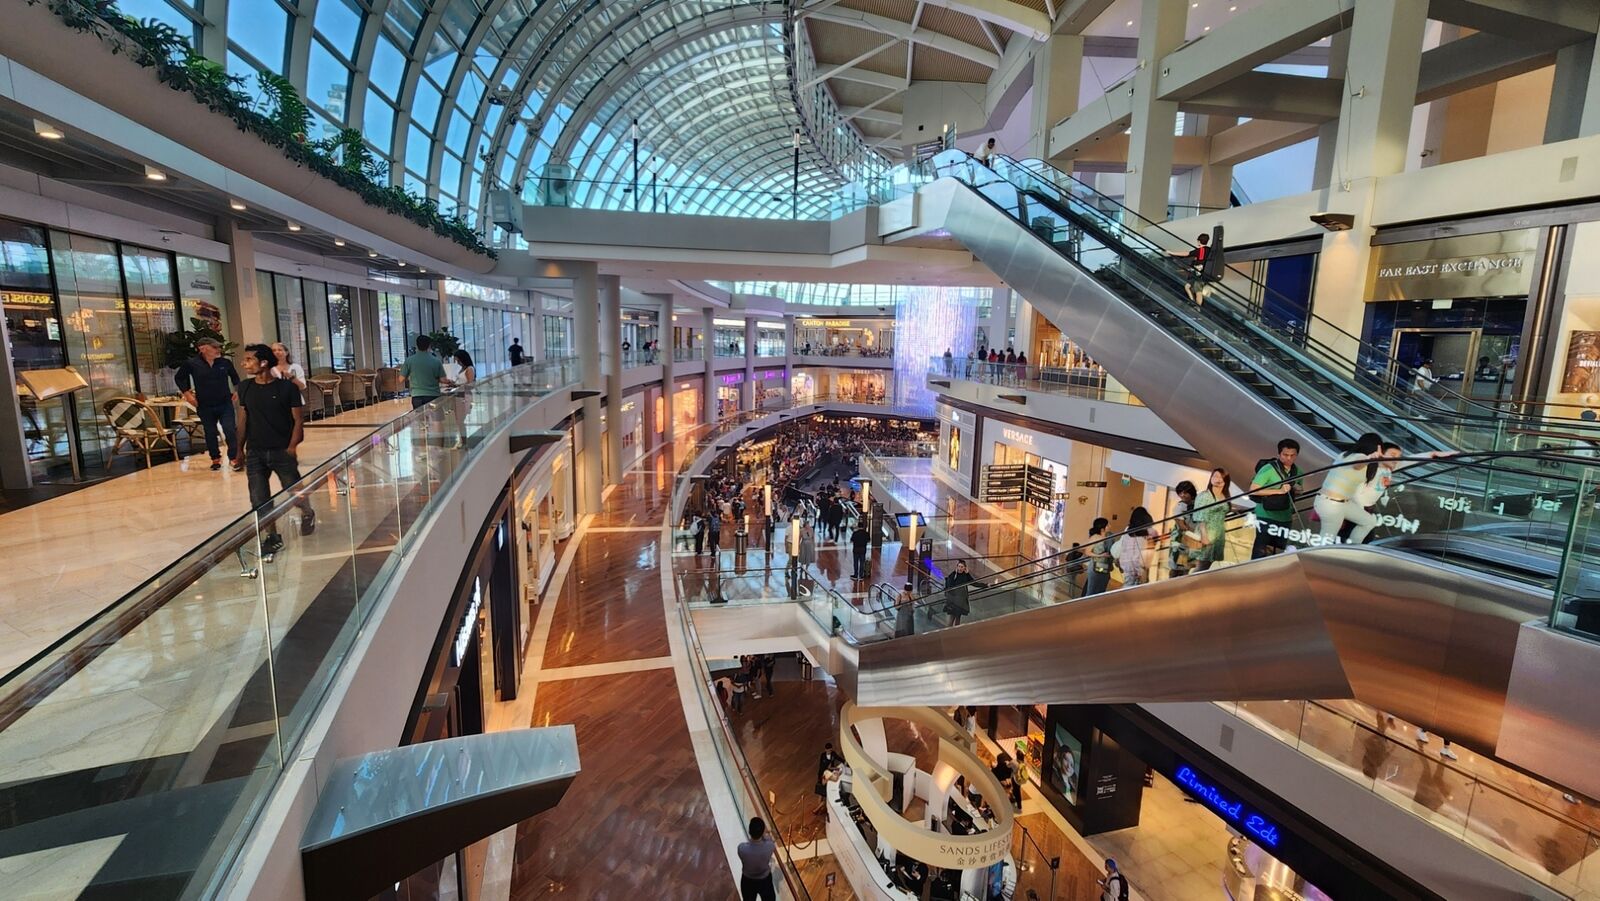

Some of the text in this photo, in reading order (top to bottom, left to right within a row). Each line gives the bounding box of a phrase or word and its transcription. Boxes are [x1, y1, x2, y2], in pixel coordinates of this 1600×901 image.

[1379, 257, 1522, 278] FAR EAST EXCHANGE
[1003, 428, 1033, 445] VERSACE
[1177, 767, 1240, 820] Limited
[939, 844, 980, 856] SANDS
